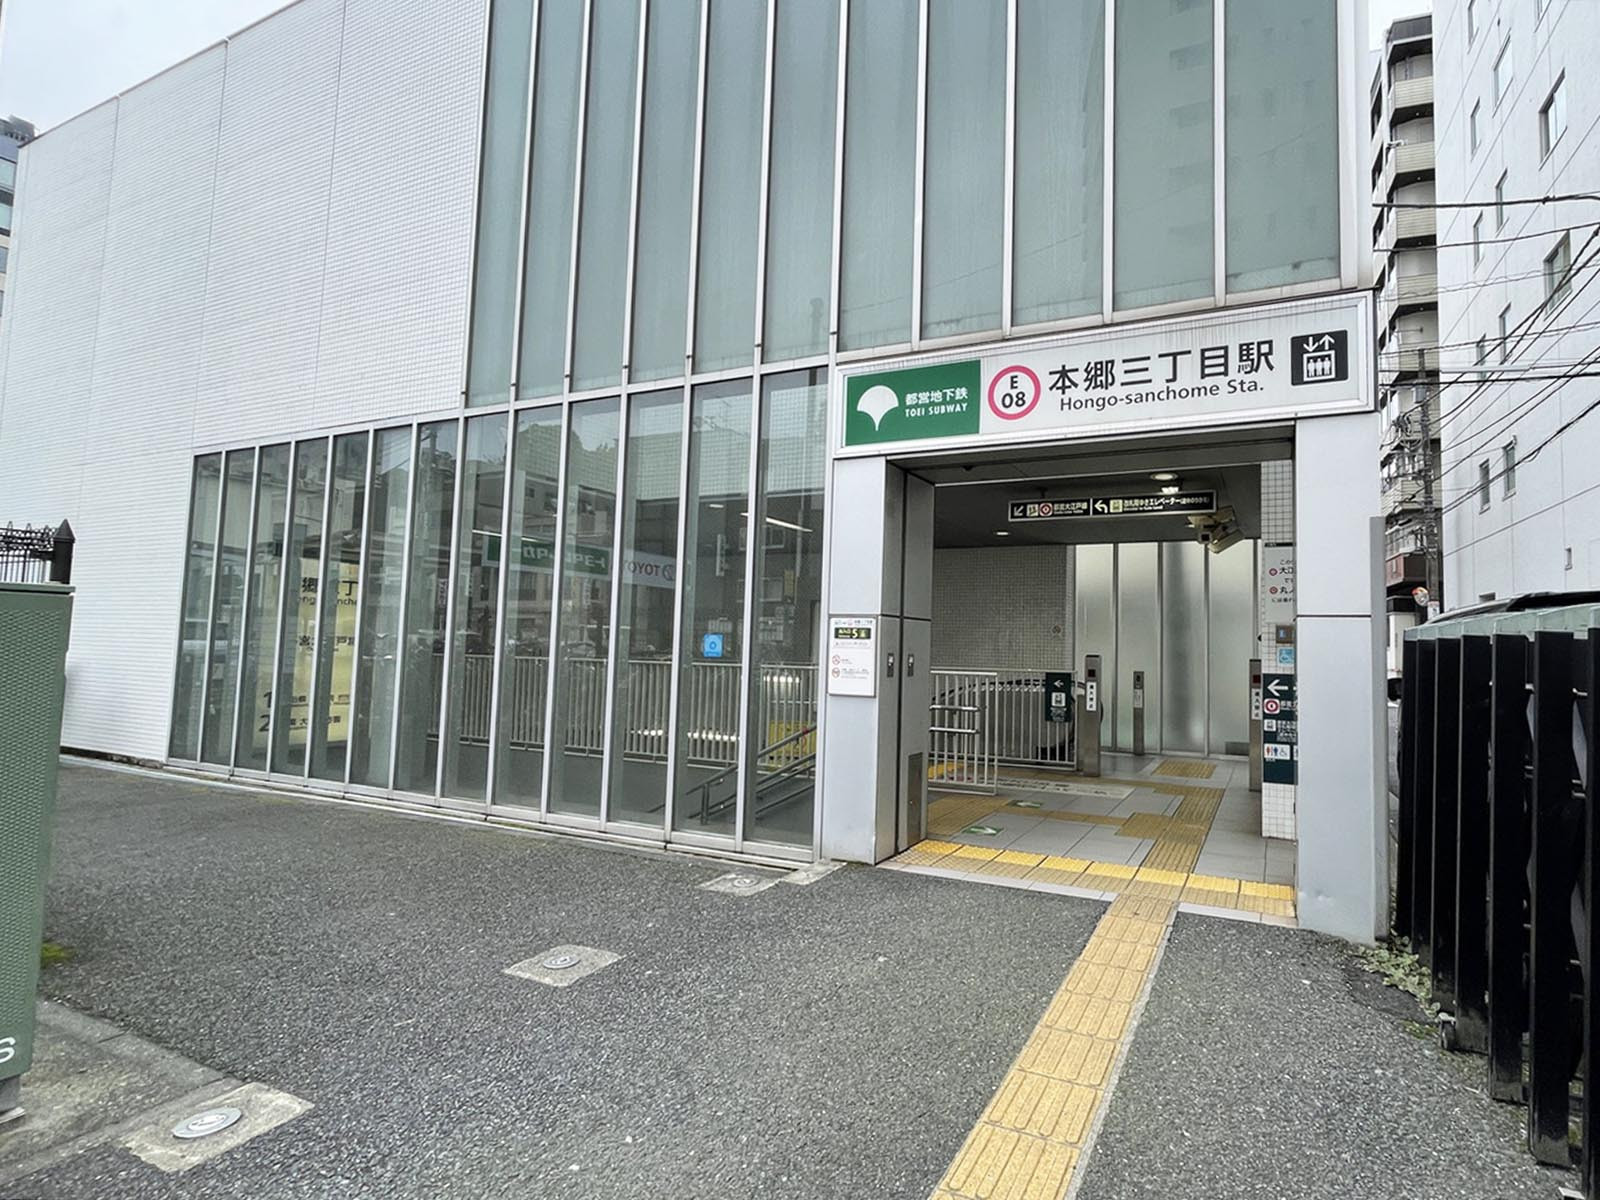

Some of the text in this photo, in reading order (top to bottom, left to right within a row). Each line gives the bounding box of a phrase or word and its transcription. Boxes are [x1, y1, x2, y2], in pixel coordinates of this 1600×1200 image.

[1049, 339, 1274, 395] 本郷三丁目駅
[1010, 375, 1018, 389] E
[905, 387, 968, 405] 都営地下鉄
[1001, 392, 1026, 408] 08
[1060, 379, 1264, 411] Hongo-sanchome Sta.
[905, 403, 968, 418] TOEI SUBWAY
